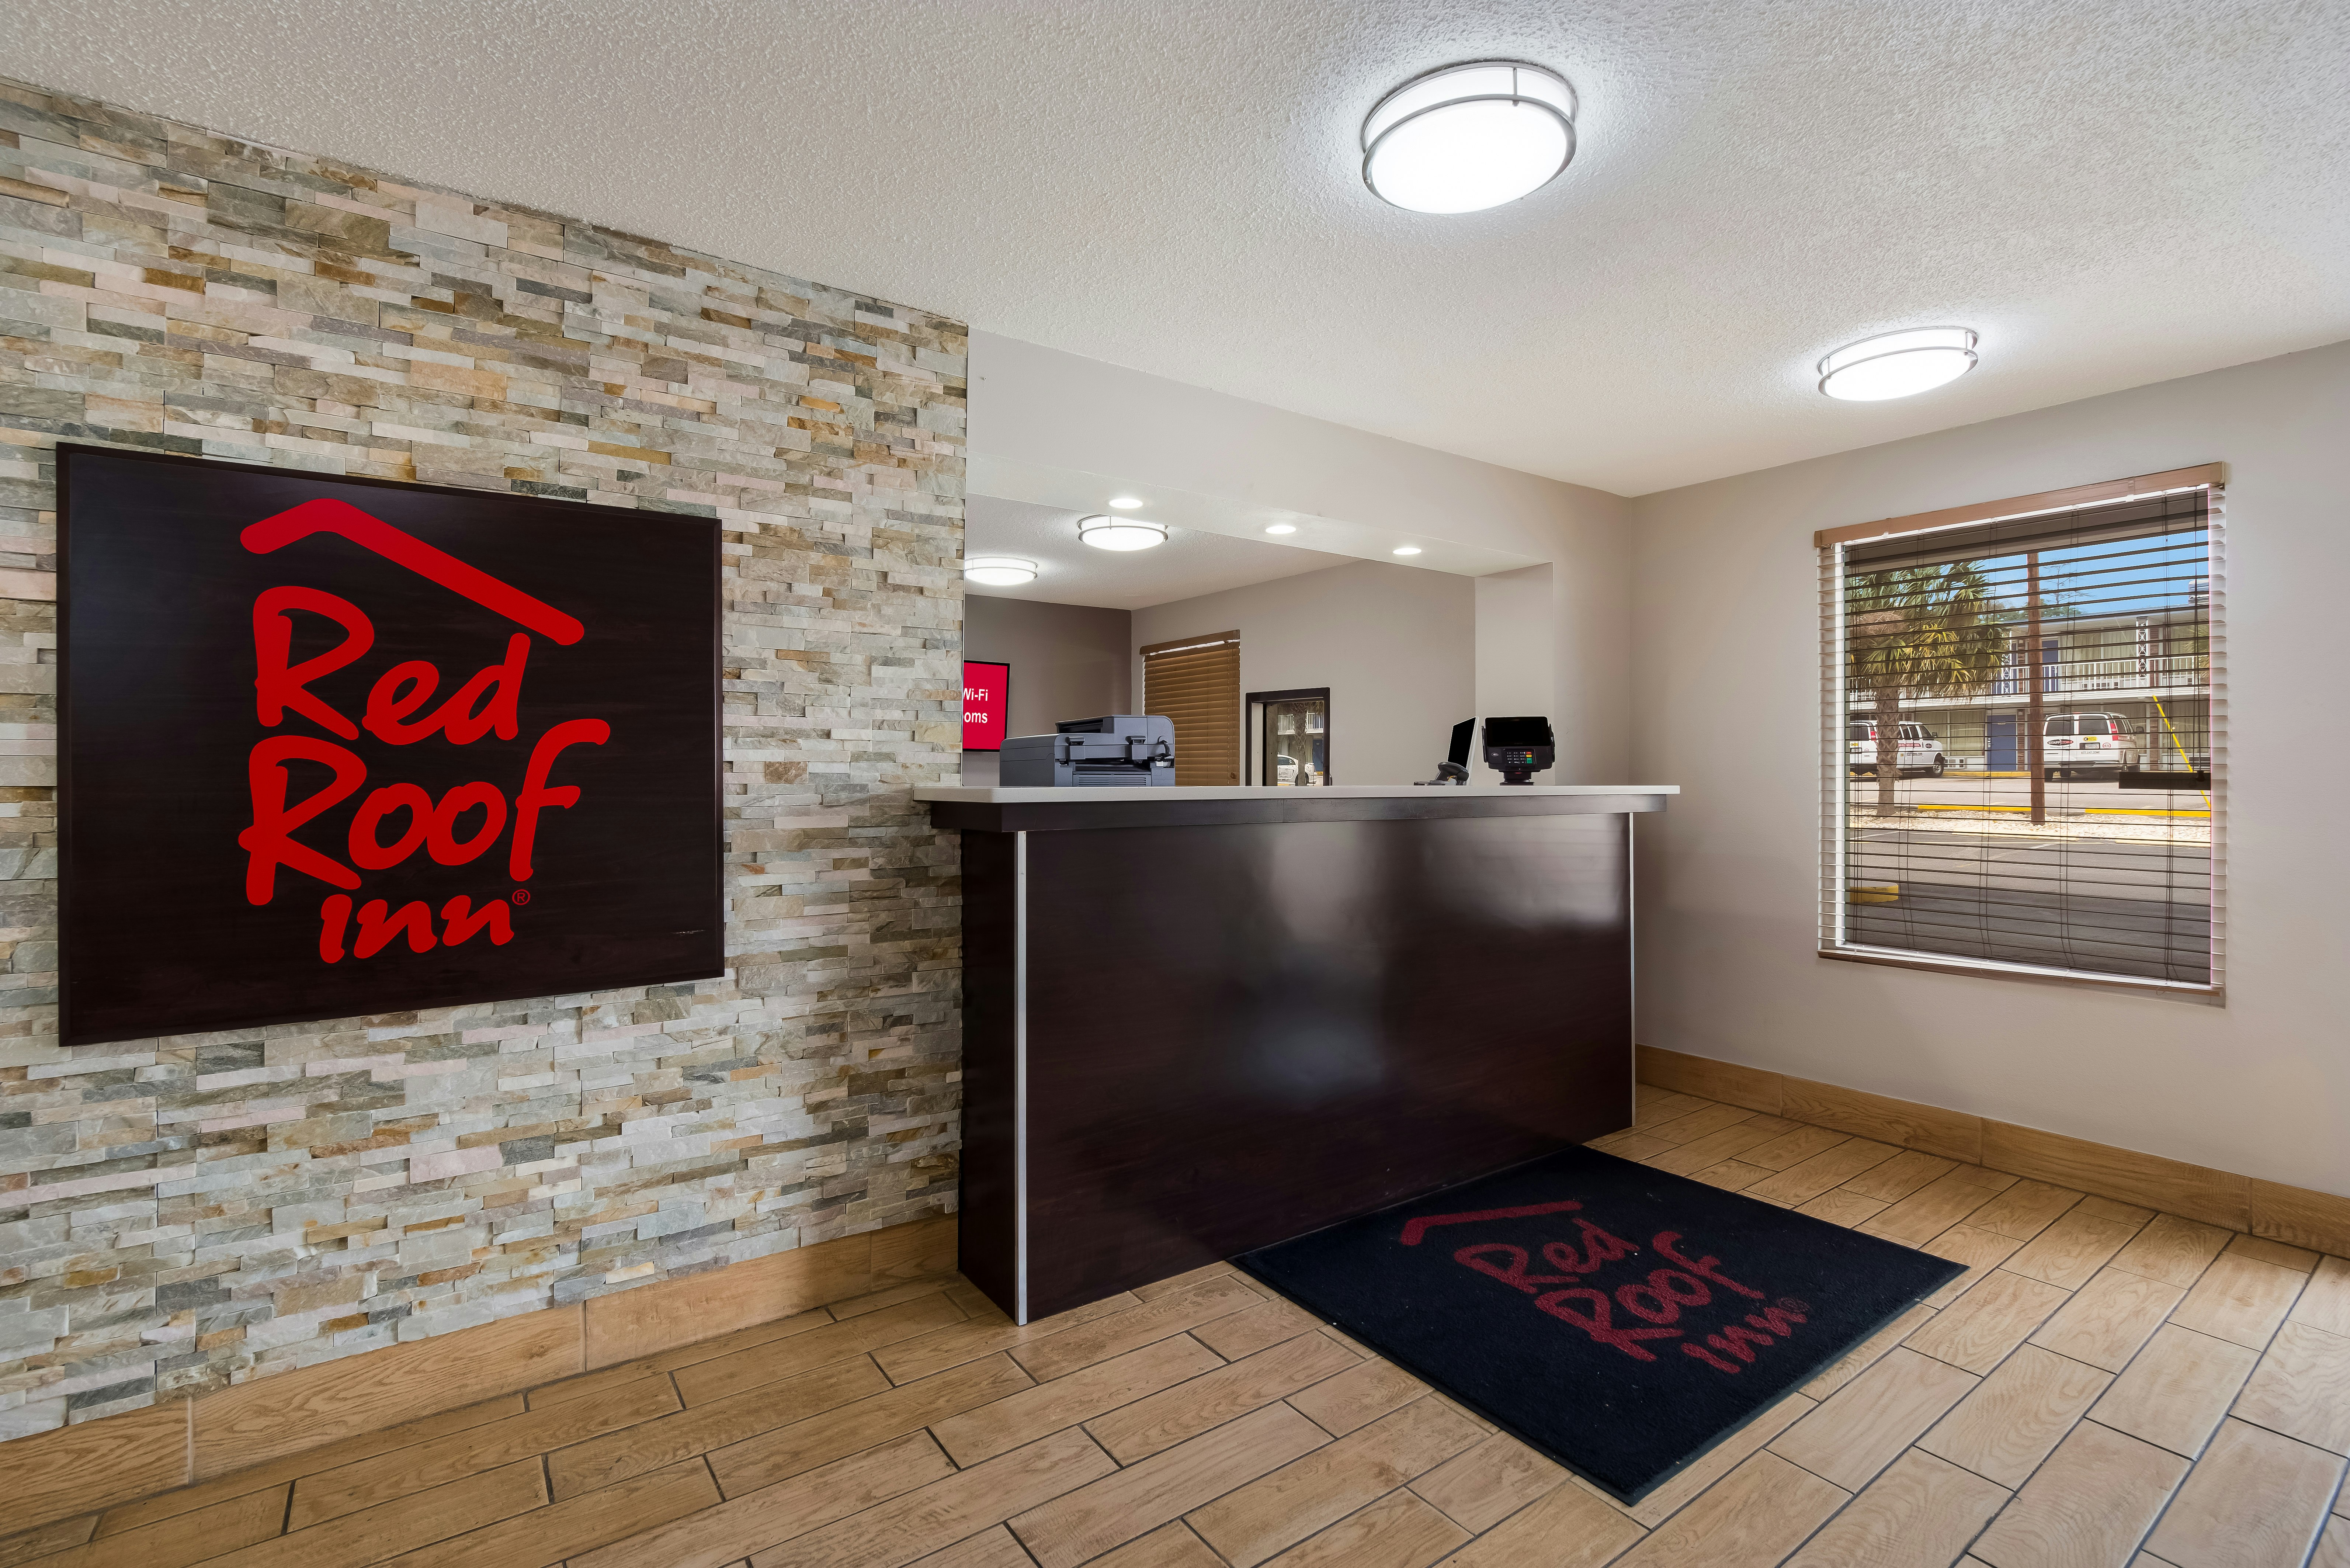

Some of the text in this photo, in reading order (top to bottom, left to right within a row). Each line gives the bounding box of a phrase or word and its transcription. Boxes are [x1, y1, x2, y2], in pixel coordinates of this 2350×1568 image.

[253, 586, 531, 745] Red
[963, 688, 988, 701] Wi-Fi
[963, 712, 988, 724] oms
[238, 719, 610, 905] Roof
[1454, 1218, 1639, 1294] Red
[1535, 1230, 1764, 1362] Roof
